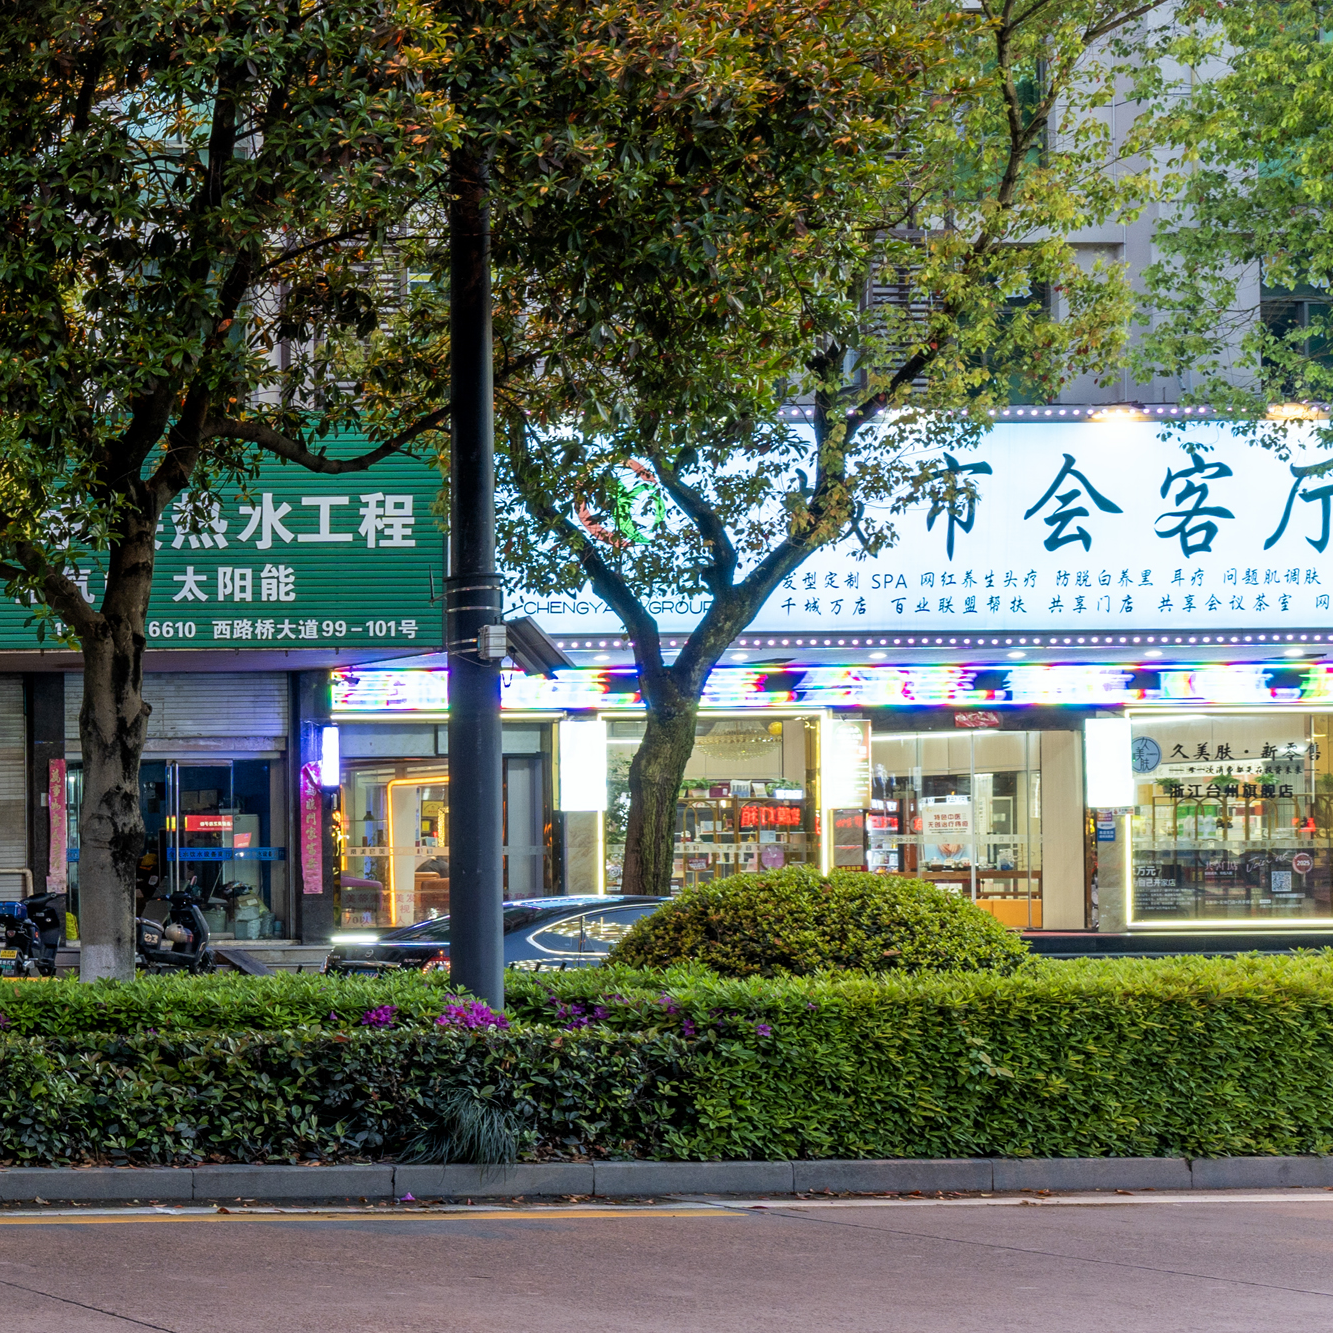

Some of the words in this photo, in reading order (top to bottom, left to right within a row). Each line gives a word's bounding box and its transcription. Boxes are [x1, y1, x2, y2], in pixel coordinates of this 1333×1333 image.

[172, 565, 296, 602] 太阳能
[782, 570, 861, 591] 发型定制
[871, 573, 908, 589] SPA
[920, 569, 1038, 589] 网红养生头疗
[1170, 567, 1205, 587] 耳疗
[781, 597, 867, 616] 千城万店
[891, 595, 1028, 615] 百业联盟帮扶
[1048, 594, 1134, 614] 共享门店
[1157, 593, 1293, 613] 共享会议茶室
[1170, 783, 1294, 798] 浙江台州旗舰店
